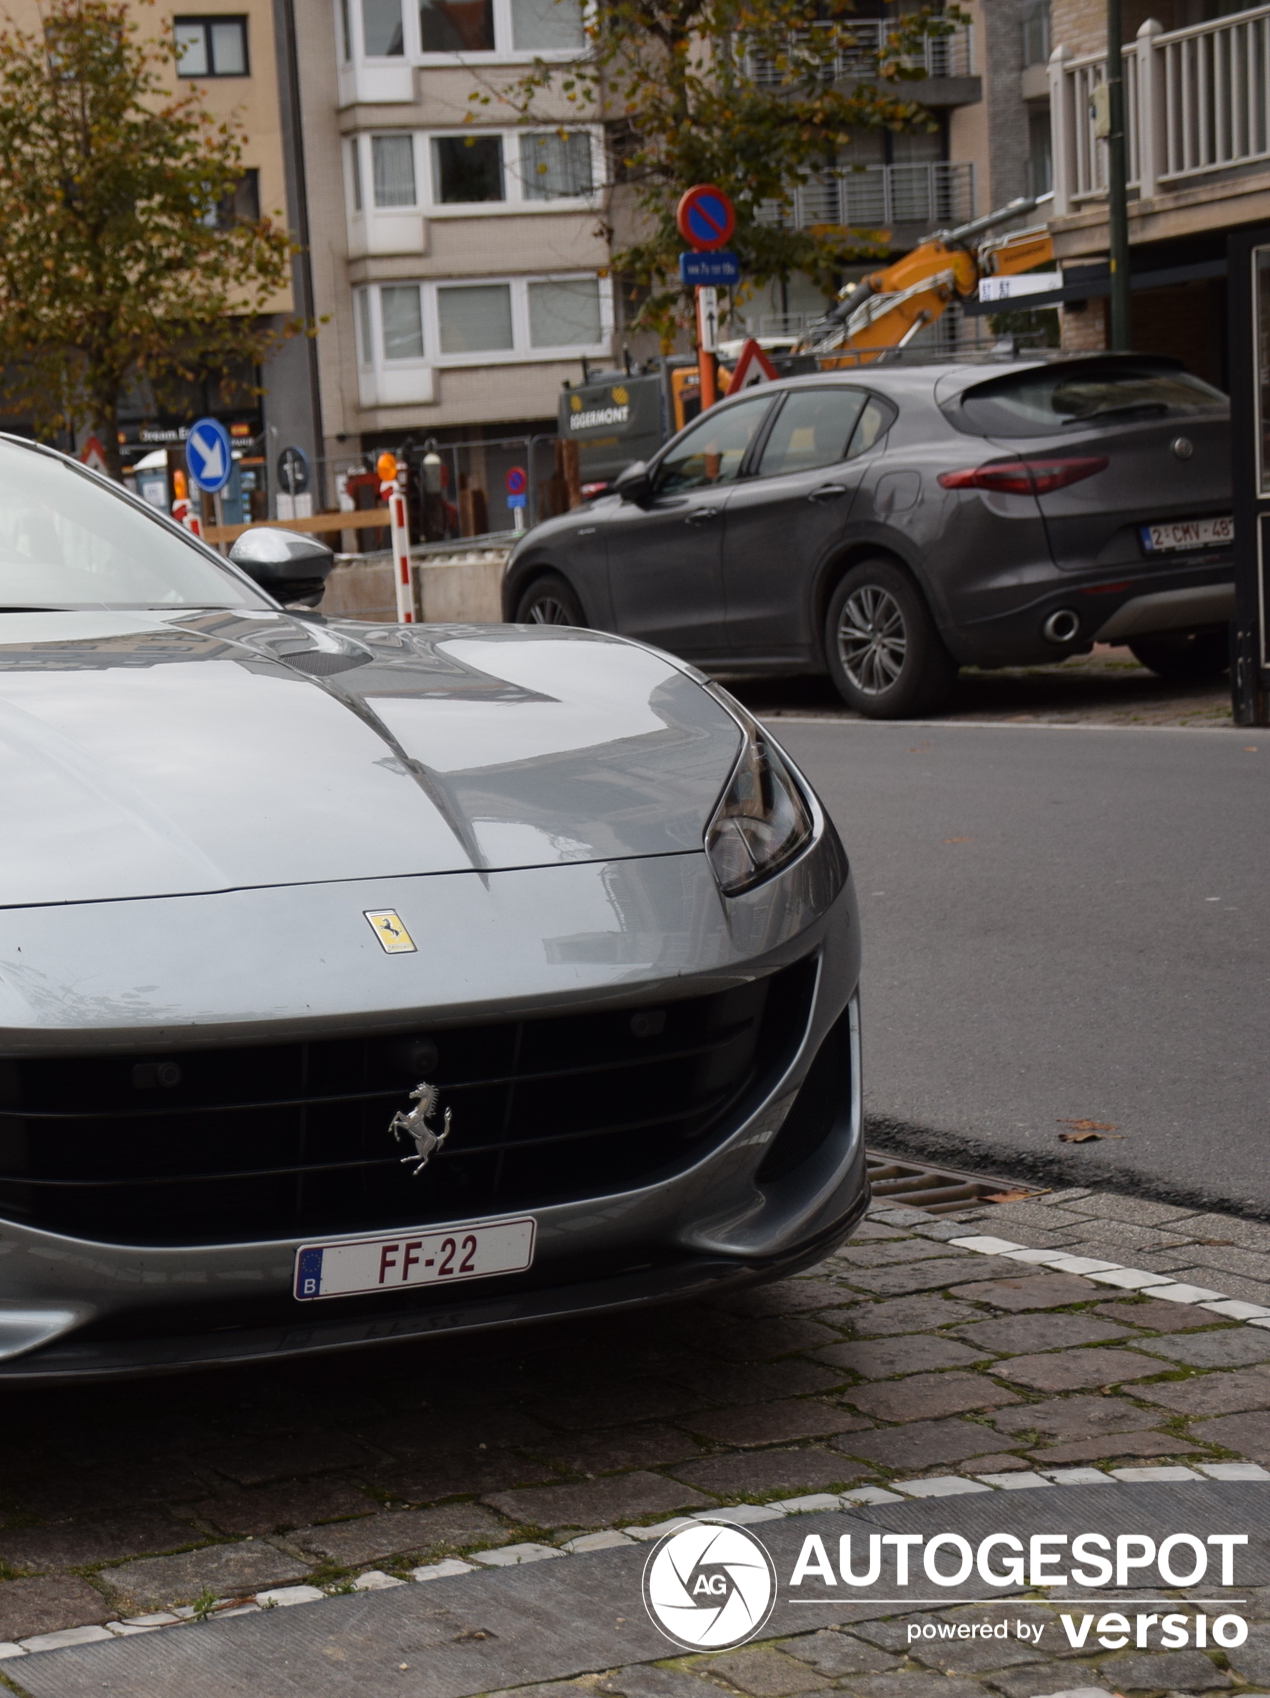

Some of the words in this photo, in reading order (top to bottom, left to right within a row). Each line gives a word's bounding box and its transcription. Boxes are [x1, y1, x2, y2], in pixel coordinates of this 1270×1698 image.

[570, 405, 629, 431] EGGERMONT
[379, 1234, 478, 1284] FF-22
[303, 1278, 316, 1294] B
